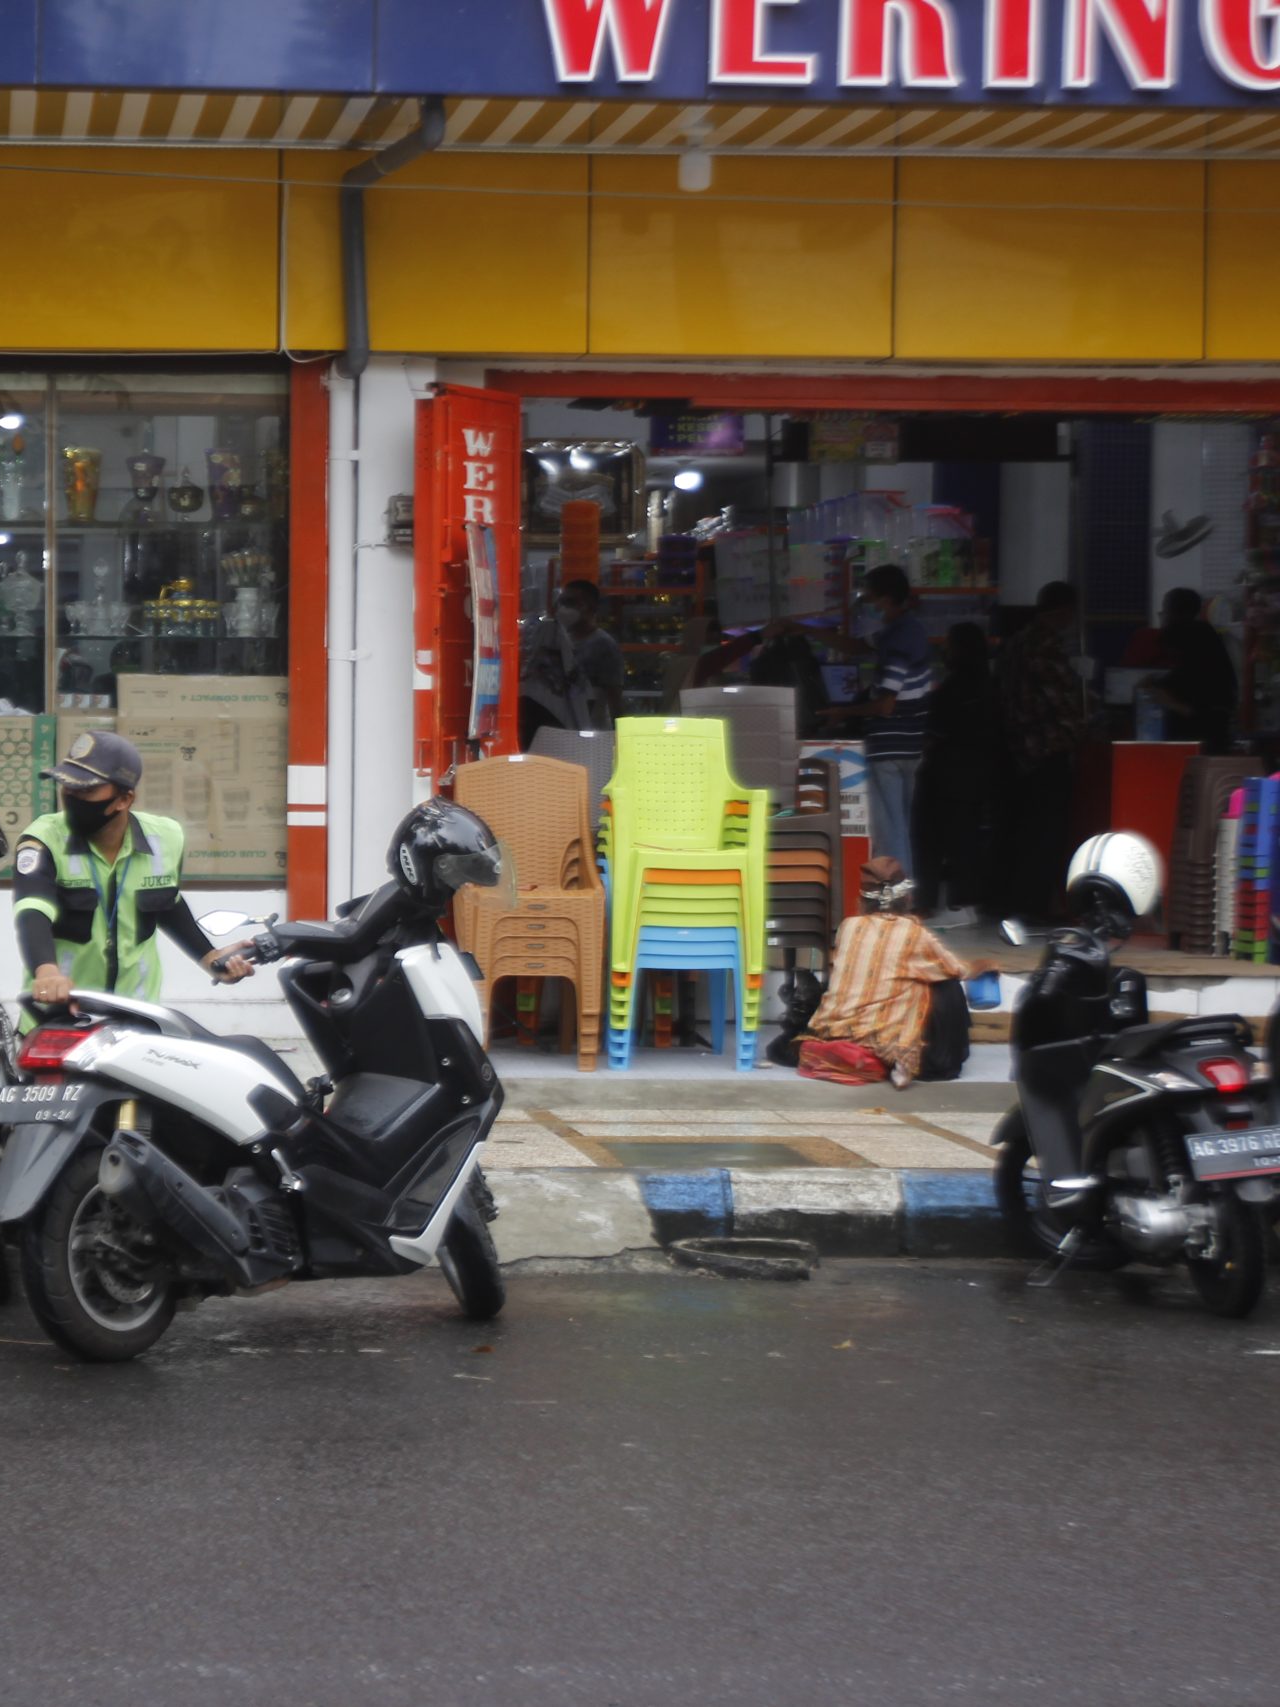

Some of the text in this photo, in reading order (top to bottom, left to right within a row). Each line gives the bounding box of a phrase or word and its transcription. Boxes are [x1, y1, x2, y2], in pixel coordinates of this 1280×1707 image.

[190, 693, 240, 702] COMPACT
[188, 850, 237, 859] COMPACT
[22, 1085, 56, 1102] 3509
[62, 1085, 84, 1102] RZ
[1194, 1141, 1216, 1157] AG
[1217, 1135, 1261, 1154] 3976
